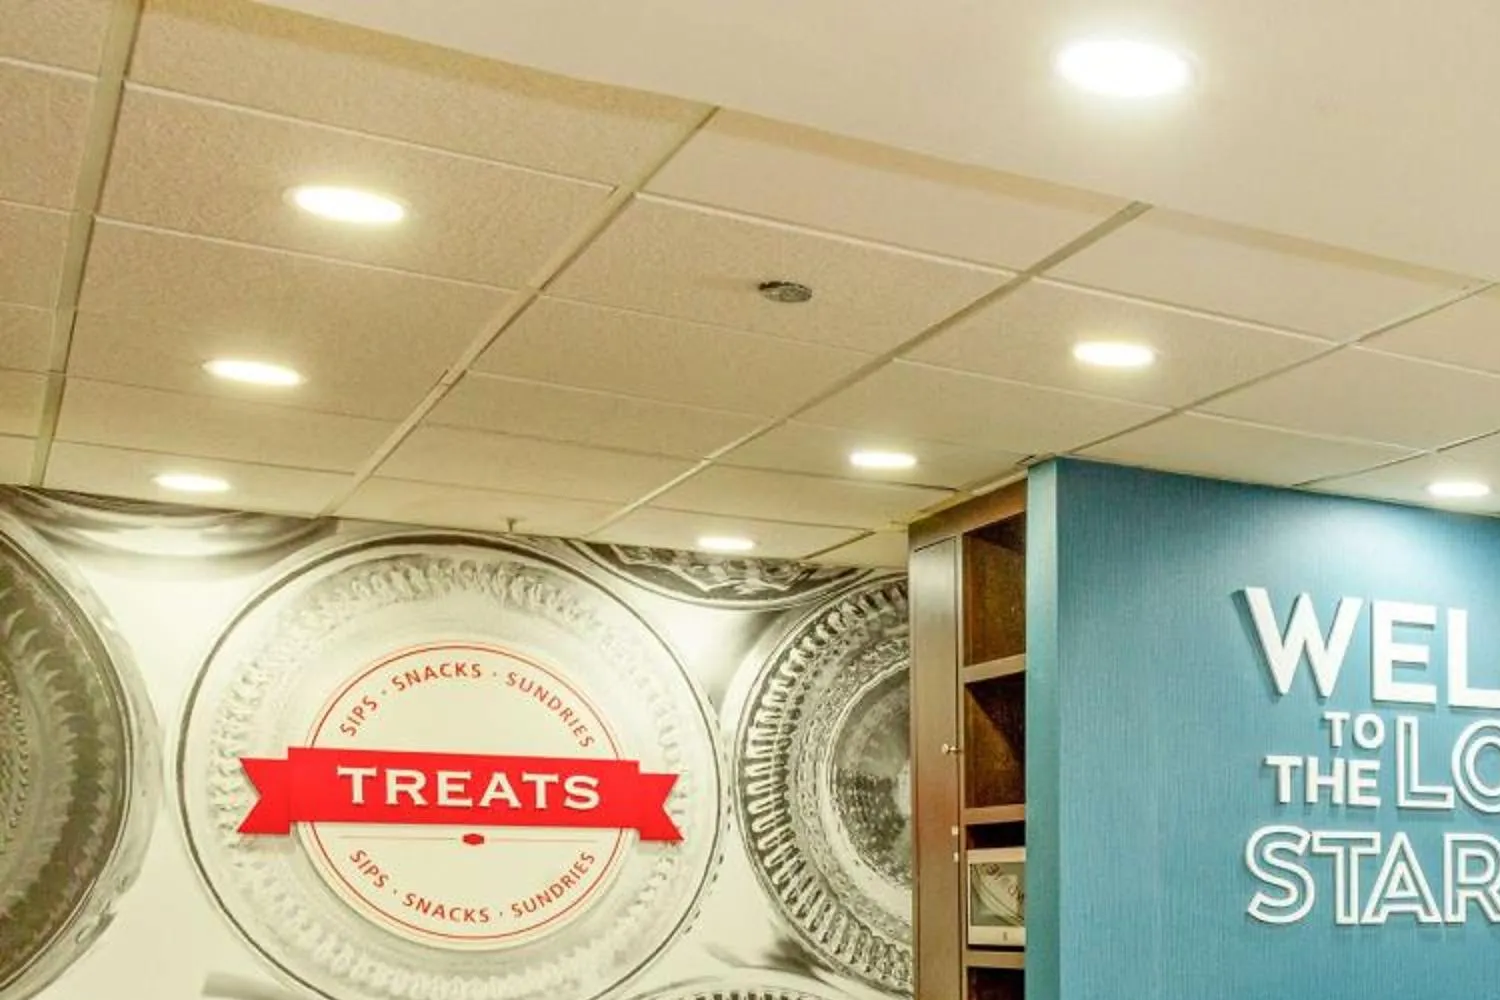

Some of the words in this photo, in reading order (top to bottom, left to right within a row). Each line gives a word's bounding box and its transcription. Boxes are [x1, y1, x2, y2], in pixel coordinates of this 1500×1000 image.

[339, 695, 378, 737] SIPS
[391, 662, 482, 692] SNACKS
[505, 671, 595, 748] SUNDRIES
[1324, 711, 1385, 749] TO
[337, 765, 600, 811] TREATS
[1265, 755, 1381, 805] THE
[350, 849, 389, 889] SIPS
[402, 892, 490, 924] SNACKS
[511, 851, 595, 918] SUNDRIES
